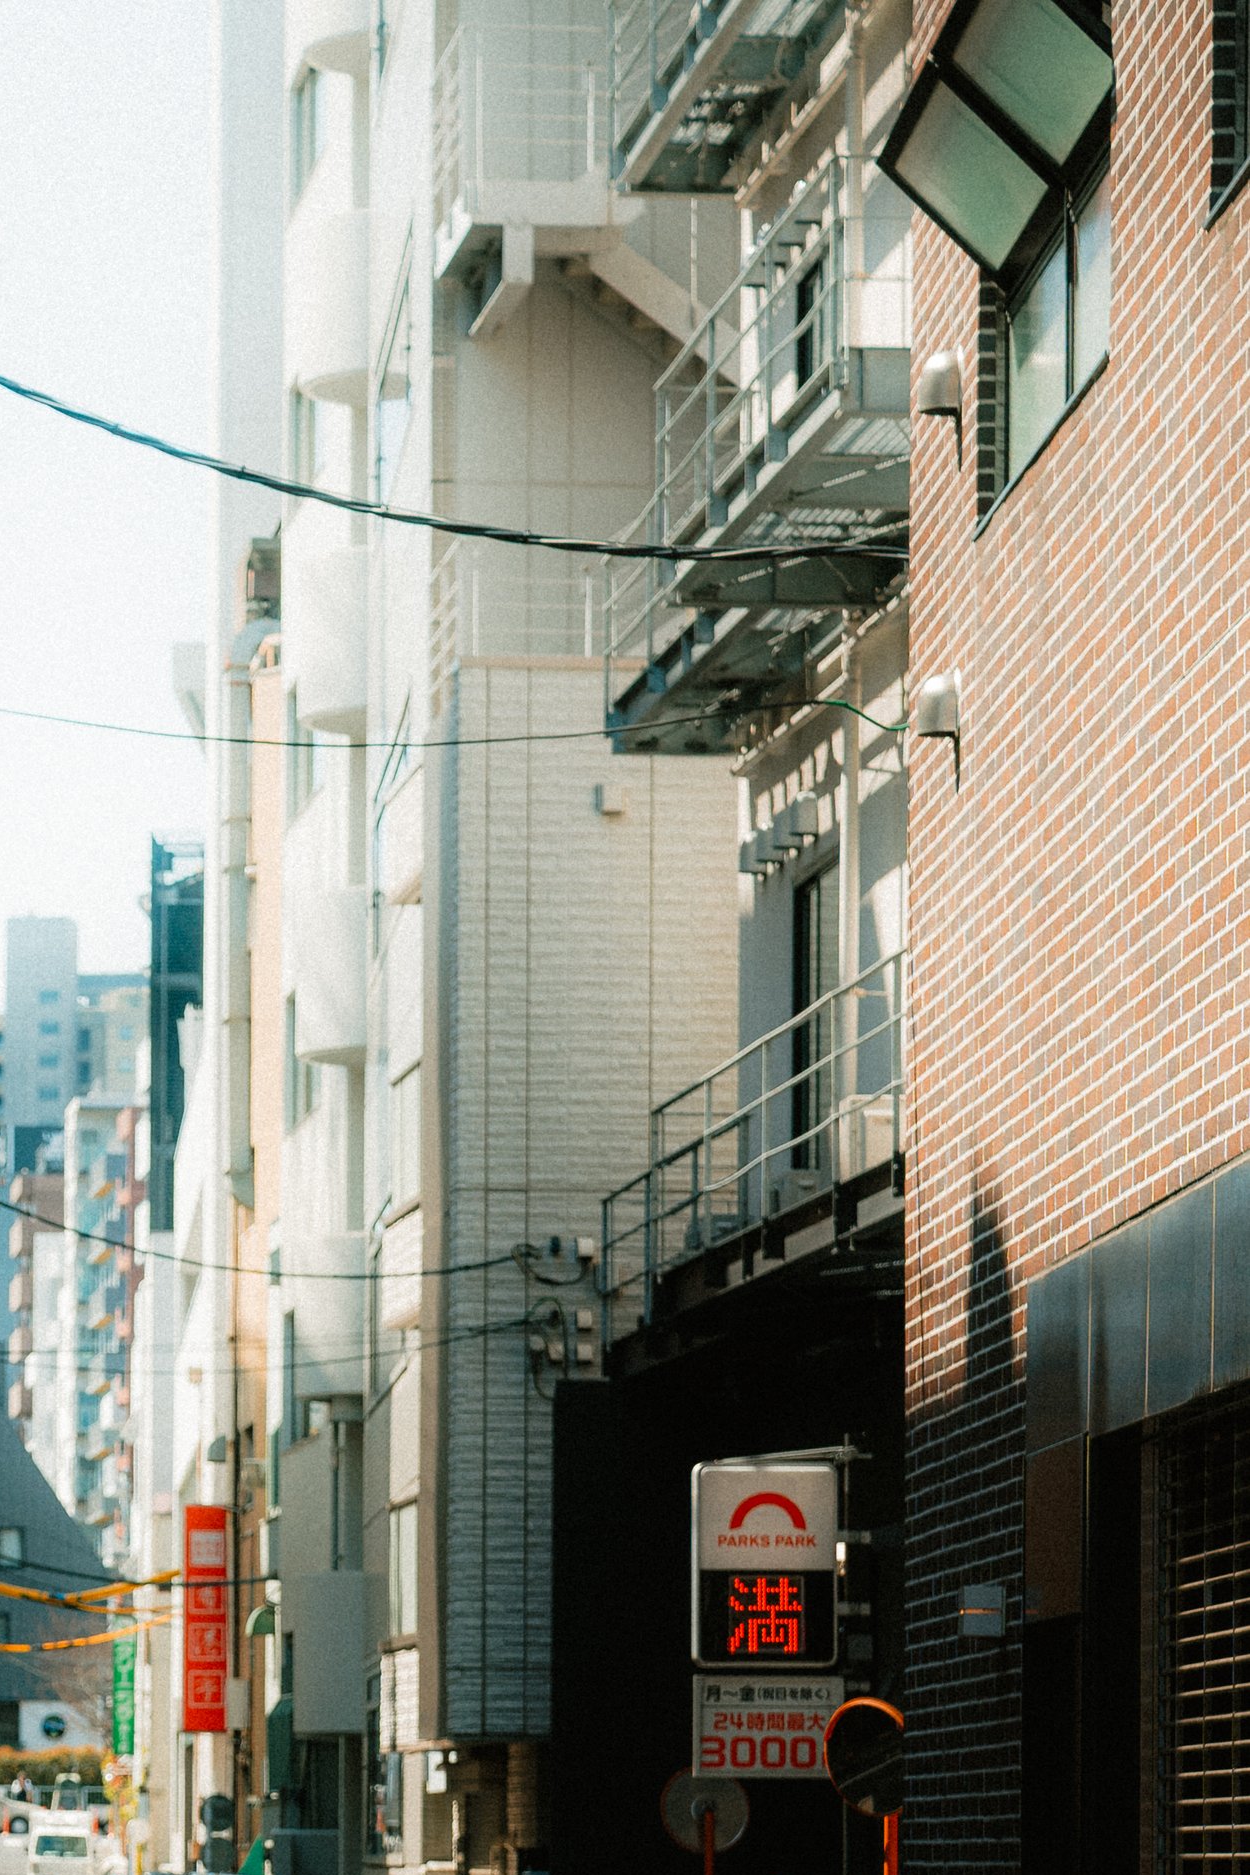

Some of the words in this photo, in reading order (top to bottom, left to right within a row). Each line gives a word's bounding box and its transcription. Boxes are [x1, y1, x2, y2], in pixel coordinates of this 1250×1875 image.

[717, 1535, 770, 1547] PARKS
[775, 1535, 817, 1547] PARK
[728, 1576, 803, 1655] 満
[713, 1712, 825, 1731] 24時間最大
[700, 1736, 826, 1769] 3000
